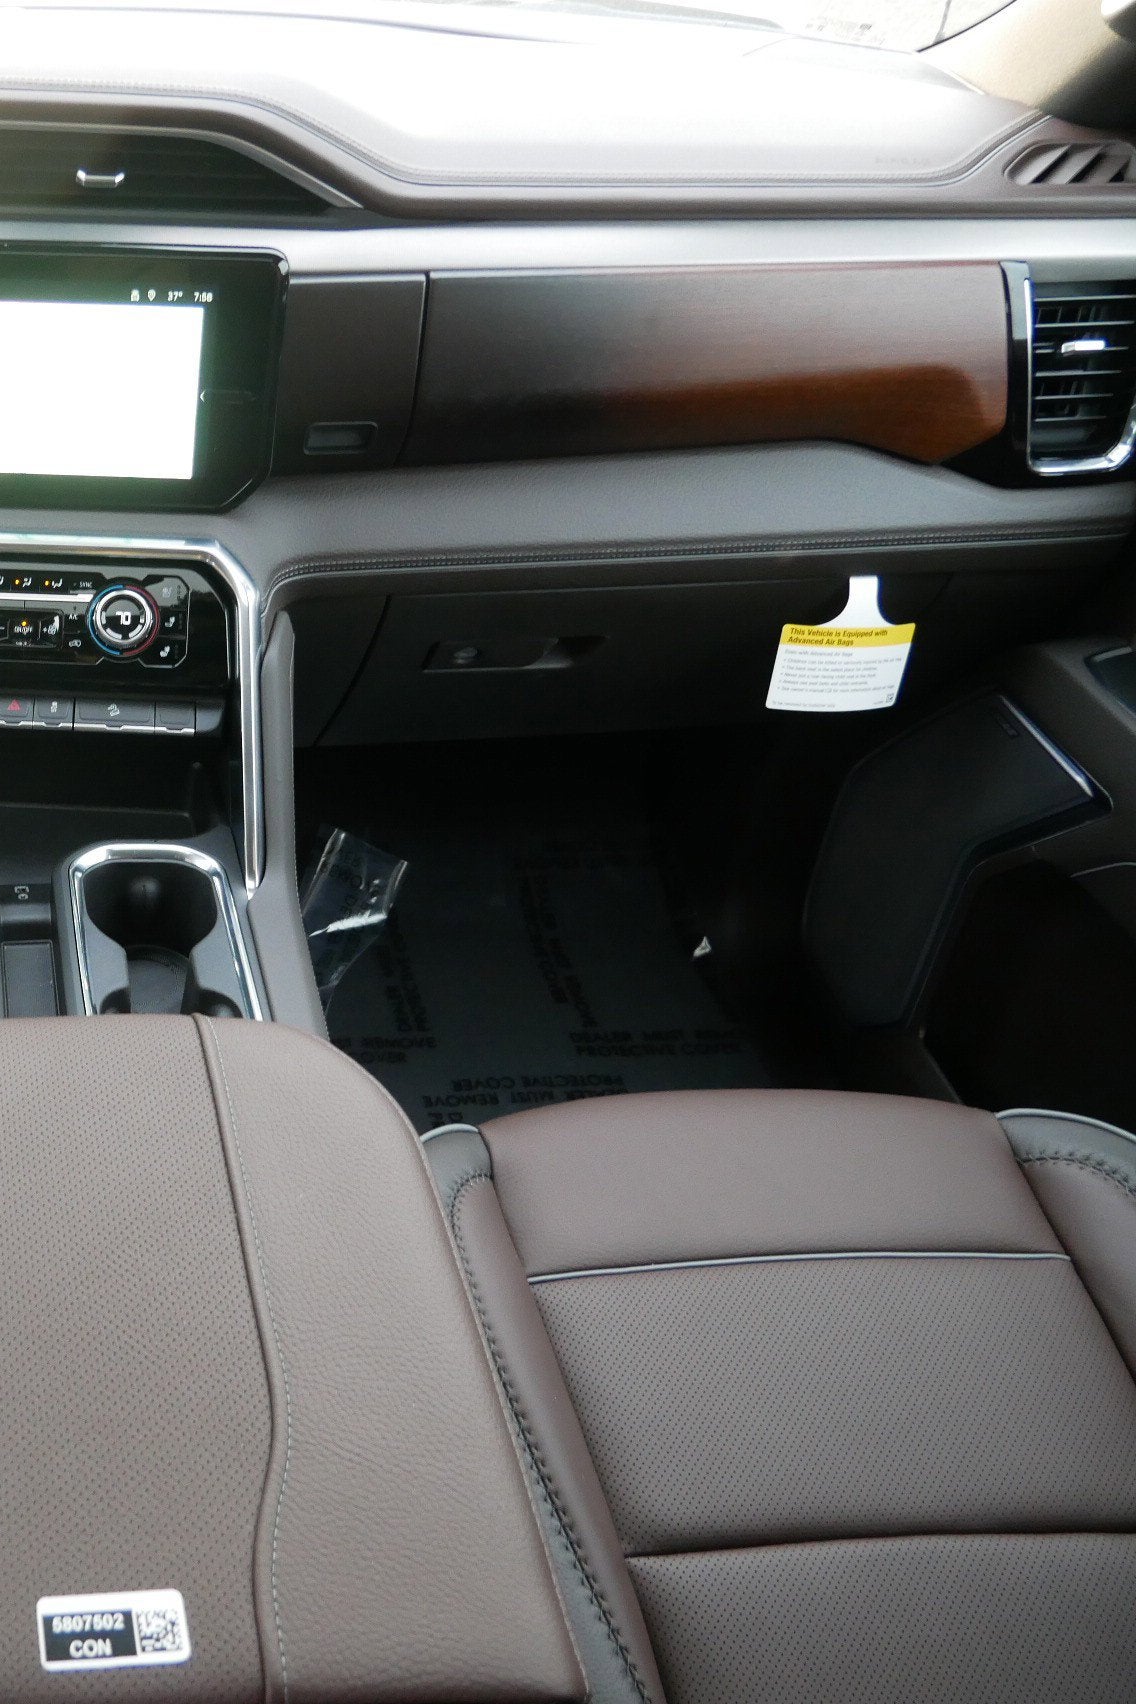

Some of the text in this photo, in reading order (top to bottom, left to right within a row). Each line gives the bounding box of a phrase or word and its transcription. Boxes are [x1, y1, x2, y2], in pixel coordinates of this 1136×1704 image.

[115, 611, 131, 625] 70
[790, 627, 805, 636] This
[807, 629, 833, 637] Vehicle
[842, 630, 874, 639] Equipped
[874, 629, 888, 637] with
[788, 636, 824, 645] Advanced
[837, 638, 854, 647] Bags
[451, 1077, 515, 1092] COVER
[423, 1092, 499, 1109] REMOVE
[69, 1637, 113, 1659] CON
